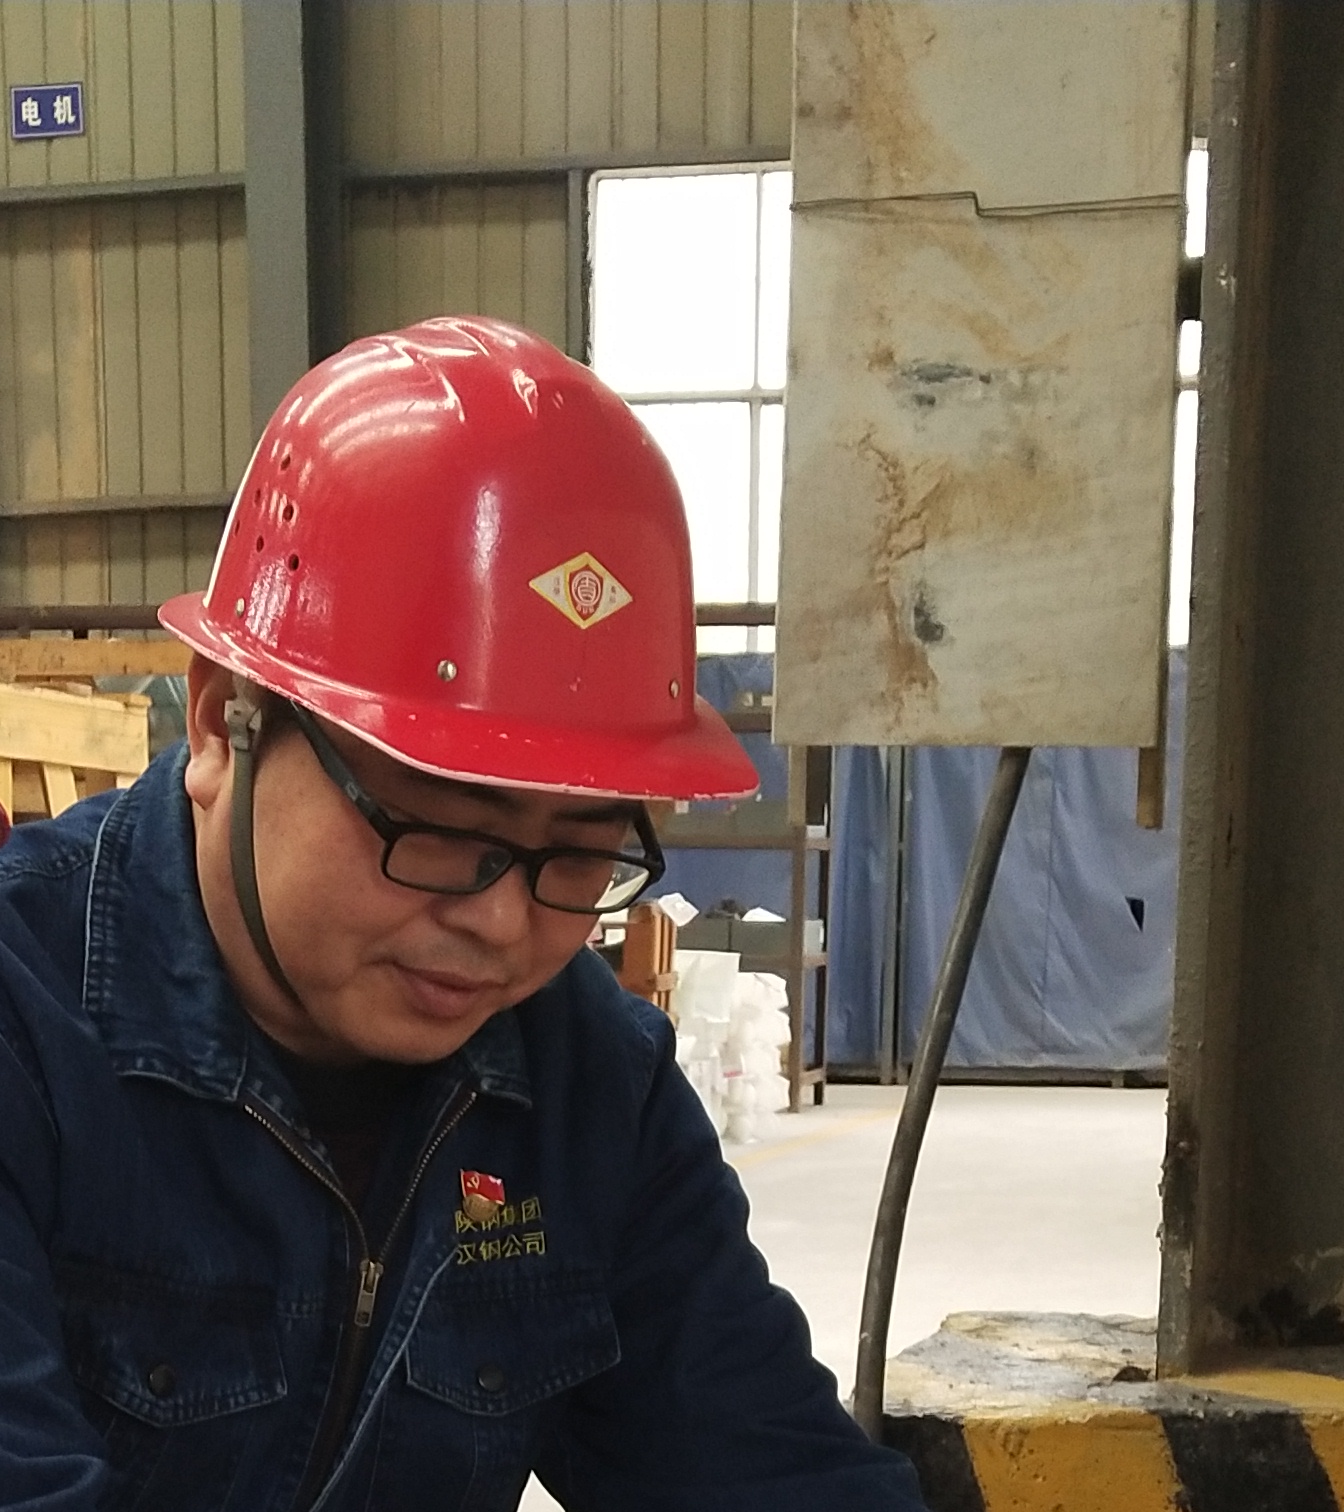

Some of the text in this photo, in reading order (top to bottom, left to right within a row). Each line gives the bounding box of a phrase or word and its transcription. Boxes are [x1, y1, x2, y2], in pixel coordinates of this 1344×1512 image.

[21, 95, 76, 127] 电机
[456, 1231, 546, 1265] 汉钢公司
